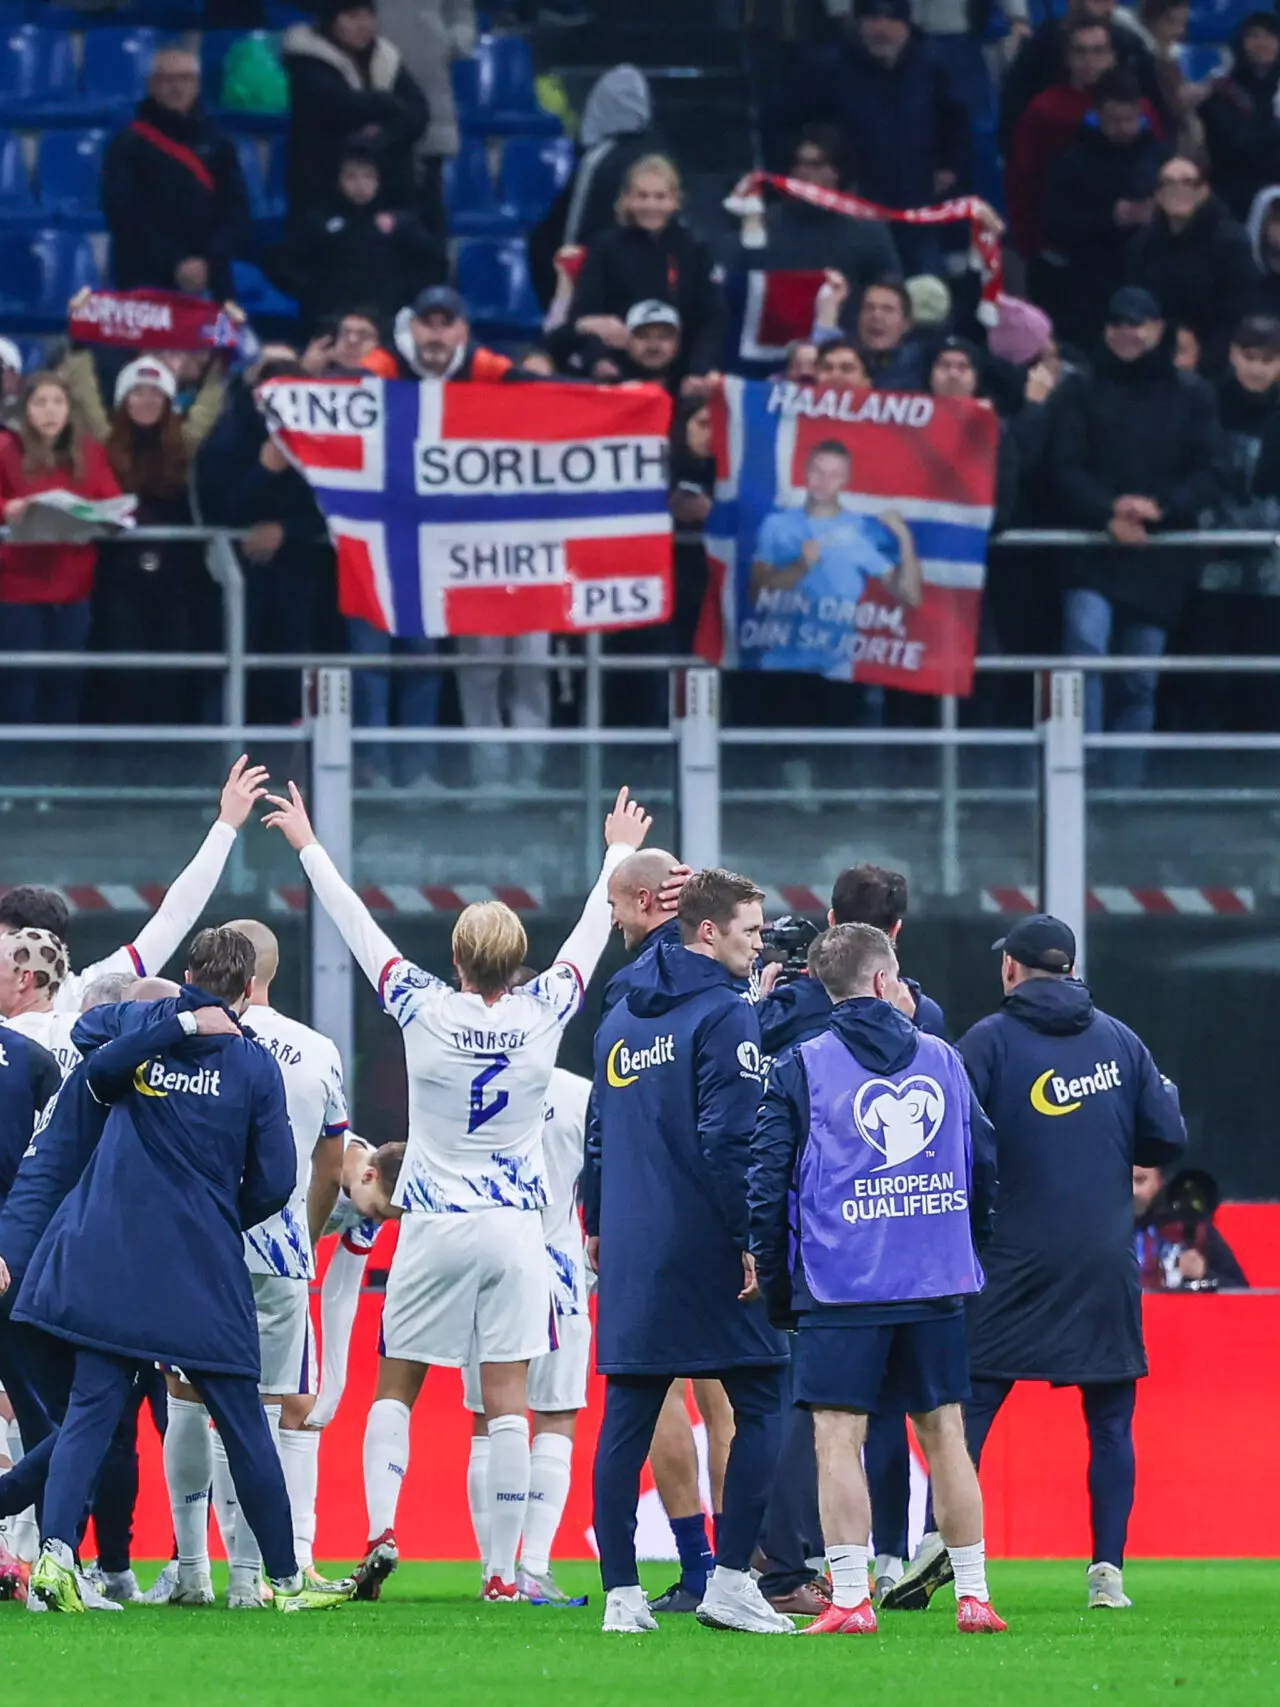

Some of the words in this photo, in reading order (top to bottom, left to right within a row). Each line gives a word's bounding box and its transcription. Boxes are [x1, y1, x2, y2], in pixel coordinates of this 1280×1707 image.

[767, 382, 934, 427] HAALAND
[422, 443, 669, 486] SORLOTH
[449, 542, 560, 580] SHIRT
[585, 581, 649, 616] PLS
[621, 1034, 675, 1075] Bendit
[149, 1062, 220, 1097] Bendit
[467, 1053, 511, 1134] 2
[1051, 1060, 1122, 1104] Bendit
[854, 1171, 954, 1197] EUROPEAN
[842, 1189, 968, 1224] QUALIFIERS
